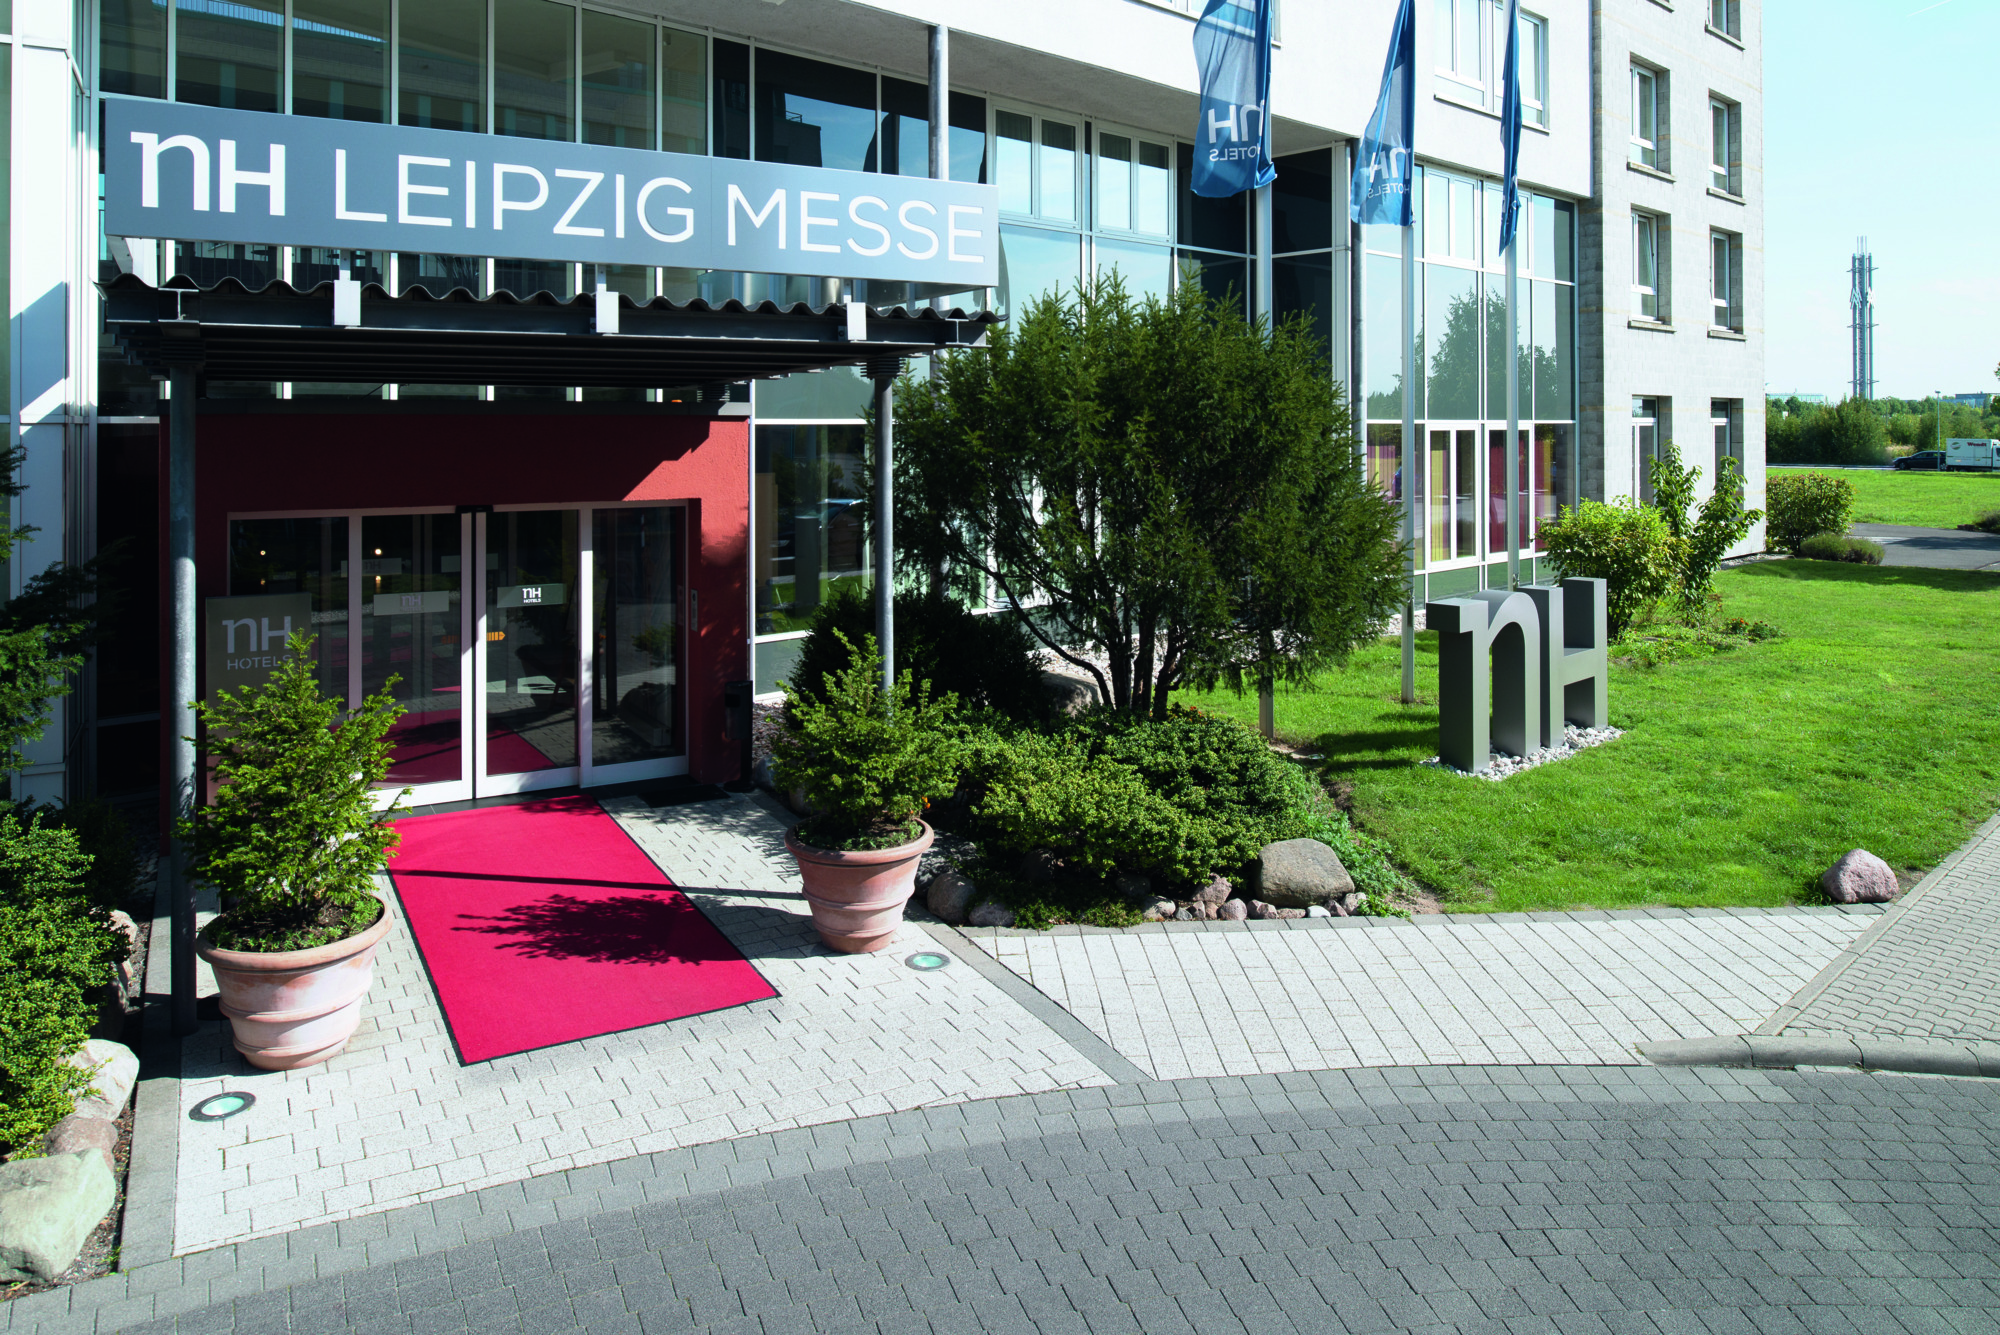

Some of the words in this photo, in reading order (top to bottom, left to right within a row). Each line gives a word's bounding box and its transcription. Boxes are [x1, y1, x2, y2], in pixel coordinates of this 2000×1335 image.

[130, 131, 285, 216] nH
[335, 148, 694, 243] LEIPZIG
[727, 183, 984, 264] MESSE
[522, 587, 542, 599] nH
[221, 615, 292, 654] nH
